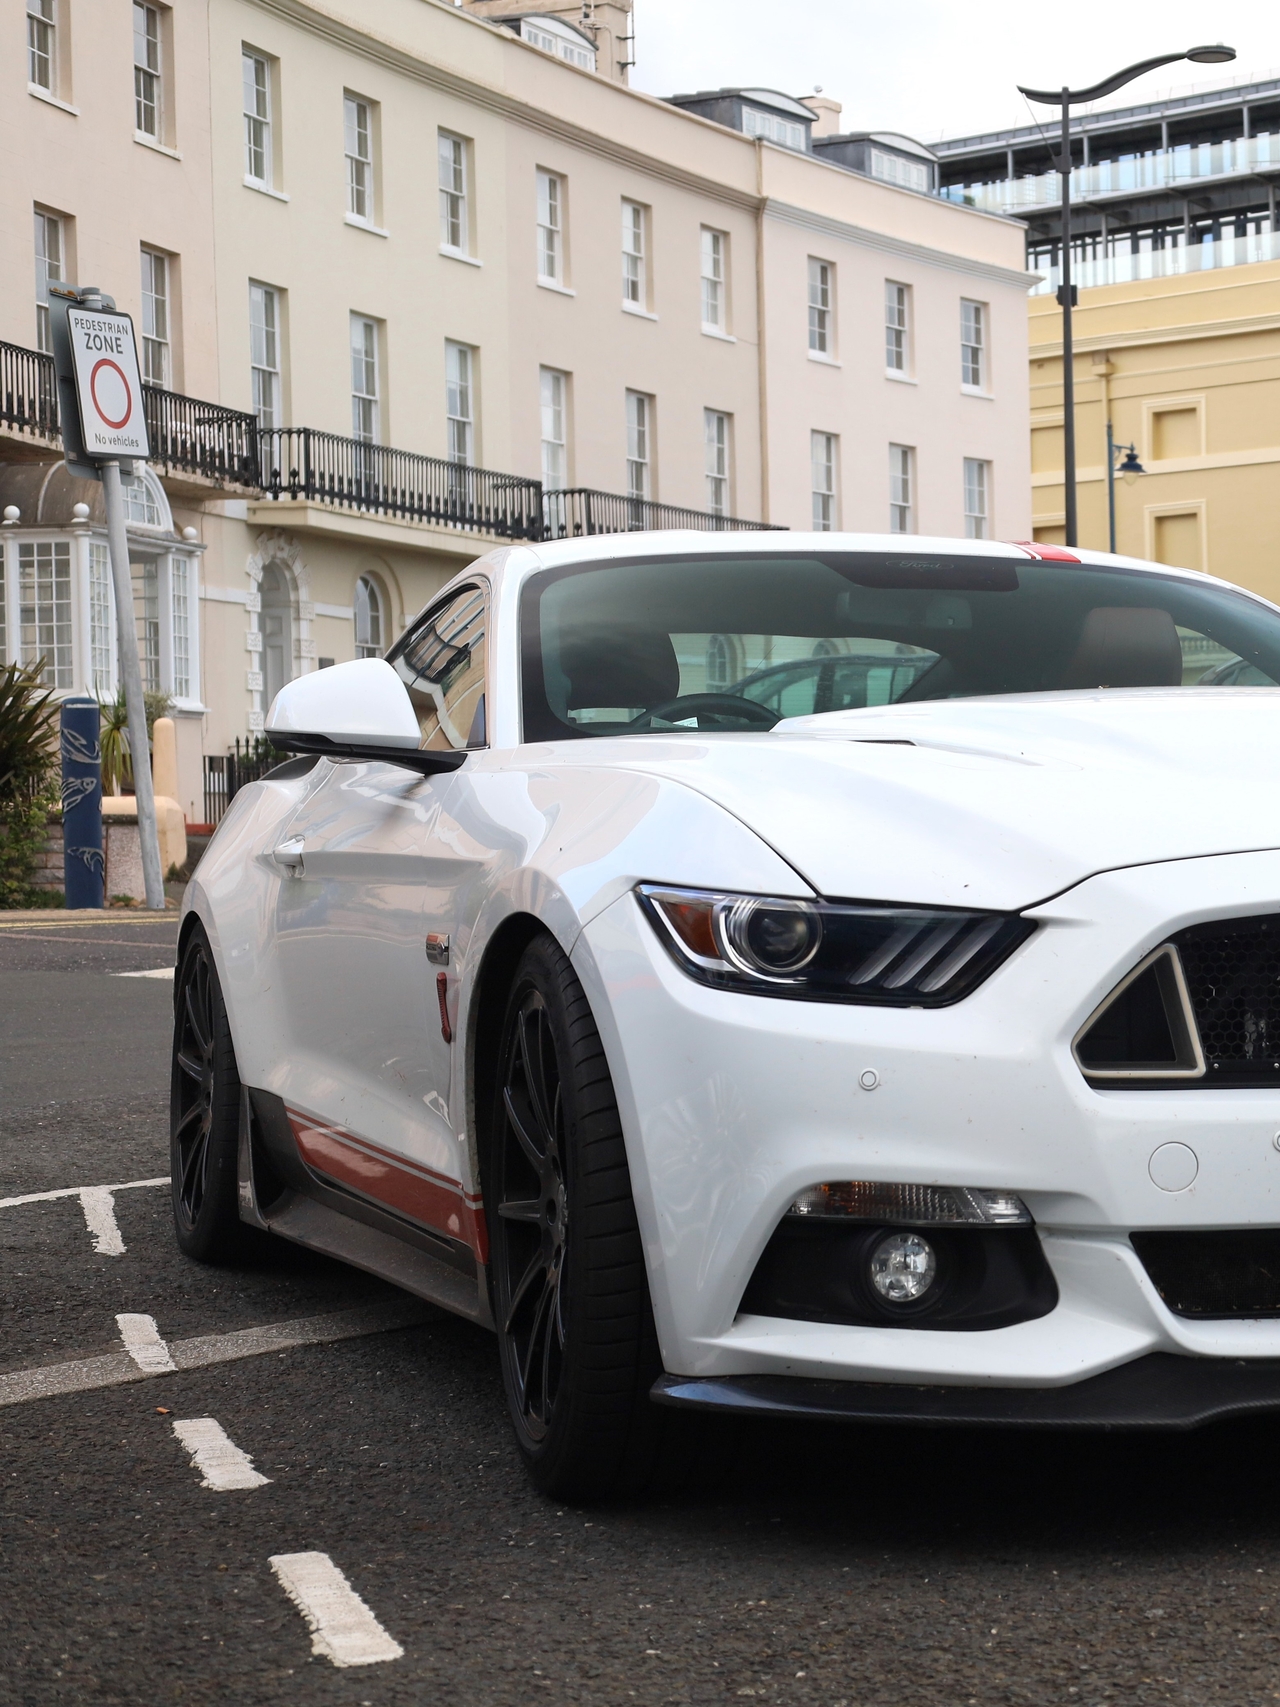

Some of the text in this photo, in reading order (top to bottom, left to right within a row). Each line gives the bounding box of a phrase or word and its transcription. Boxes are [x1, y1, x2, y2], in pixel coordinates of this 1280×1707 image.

[74, 318, 129, 336] PEDESTRIAN
[84, 332, 124, 355] ZONE
[95, 433, 140, 448] No vehicles
[899, 561, 942, 569] Ford
